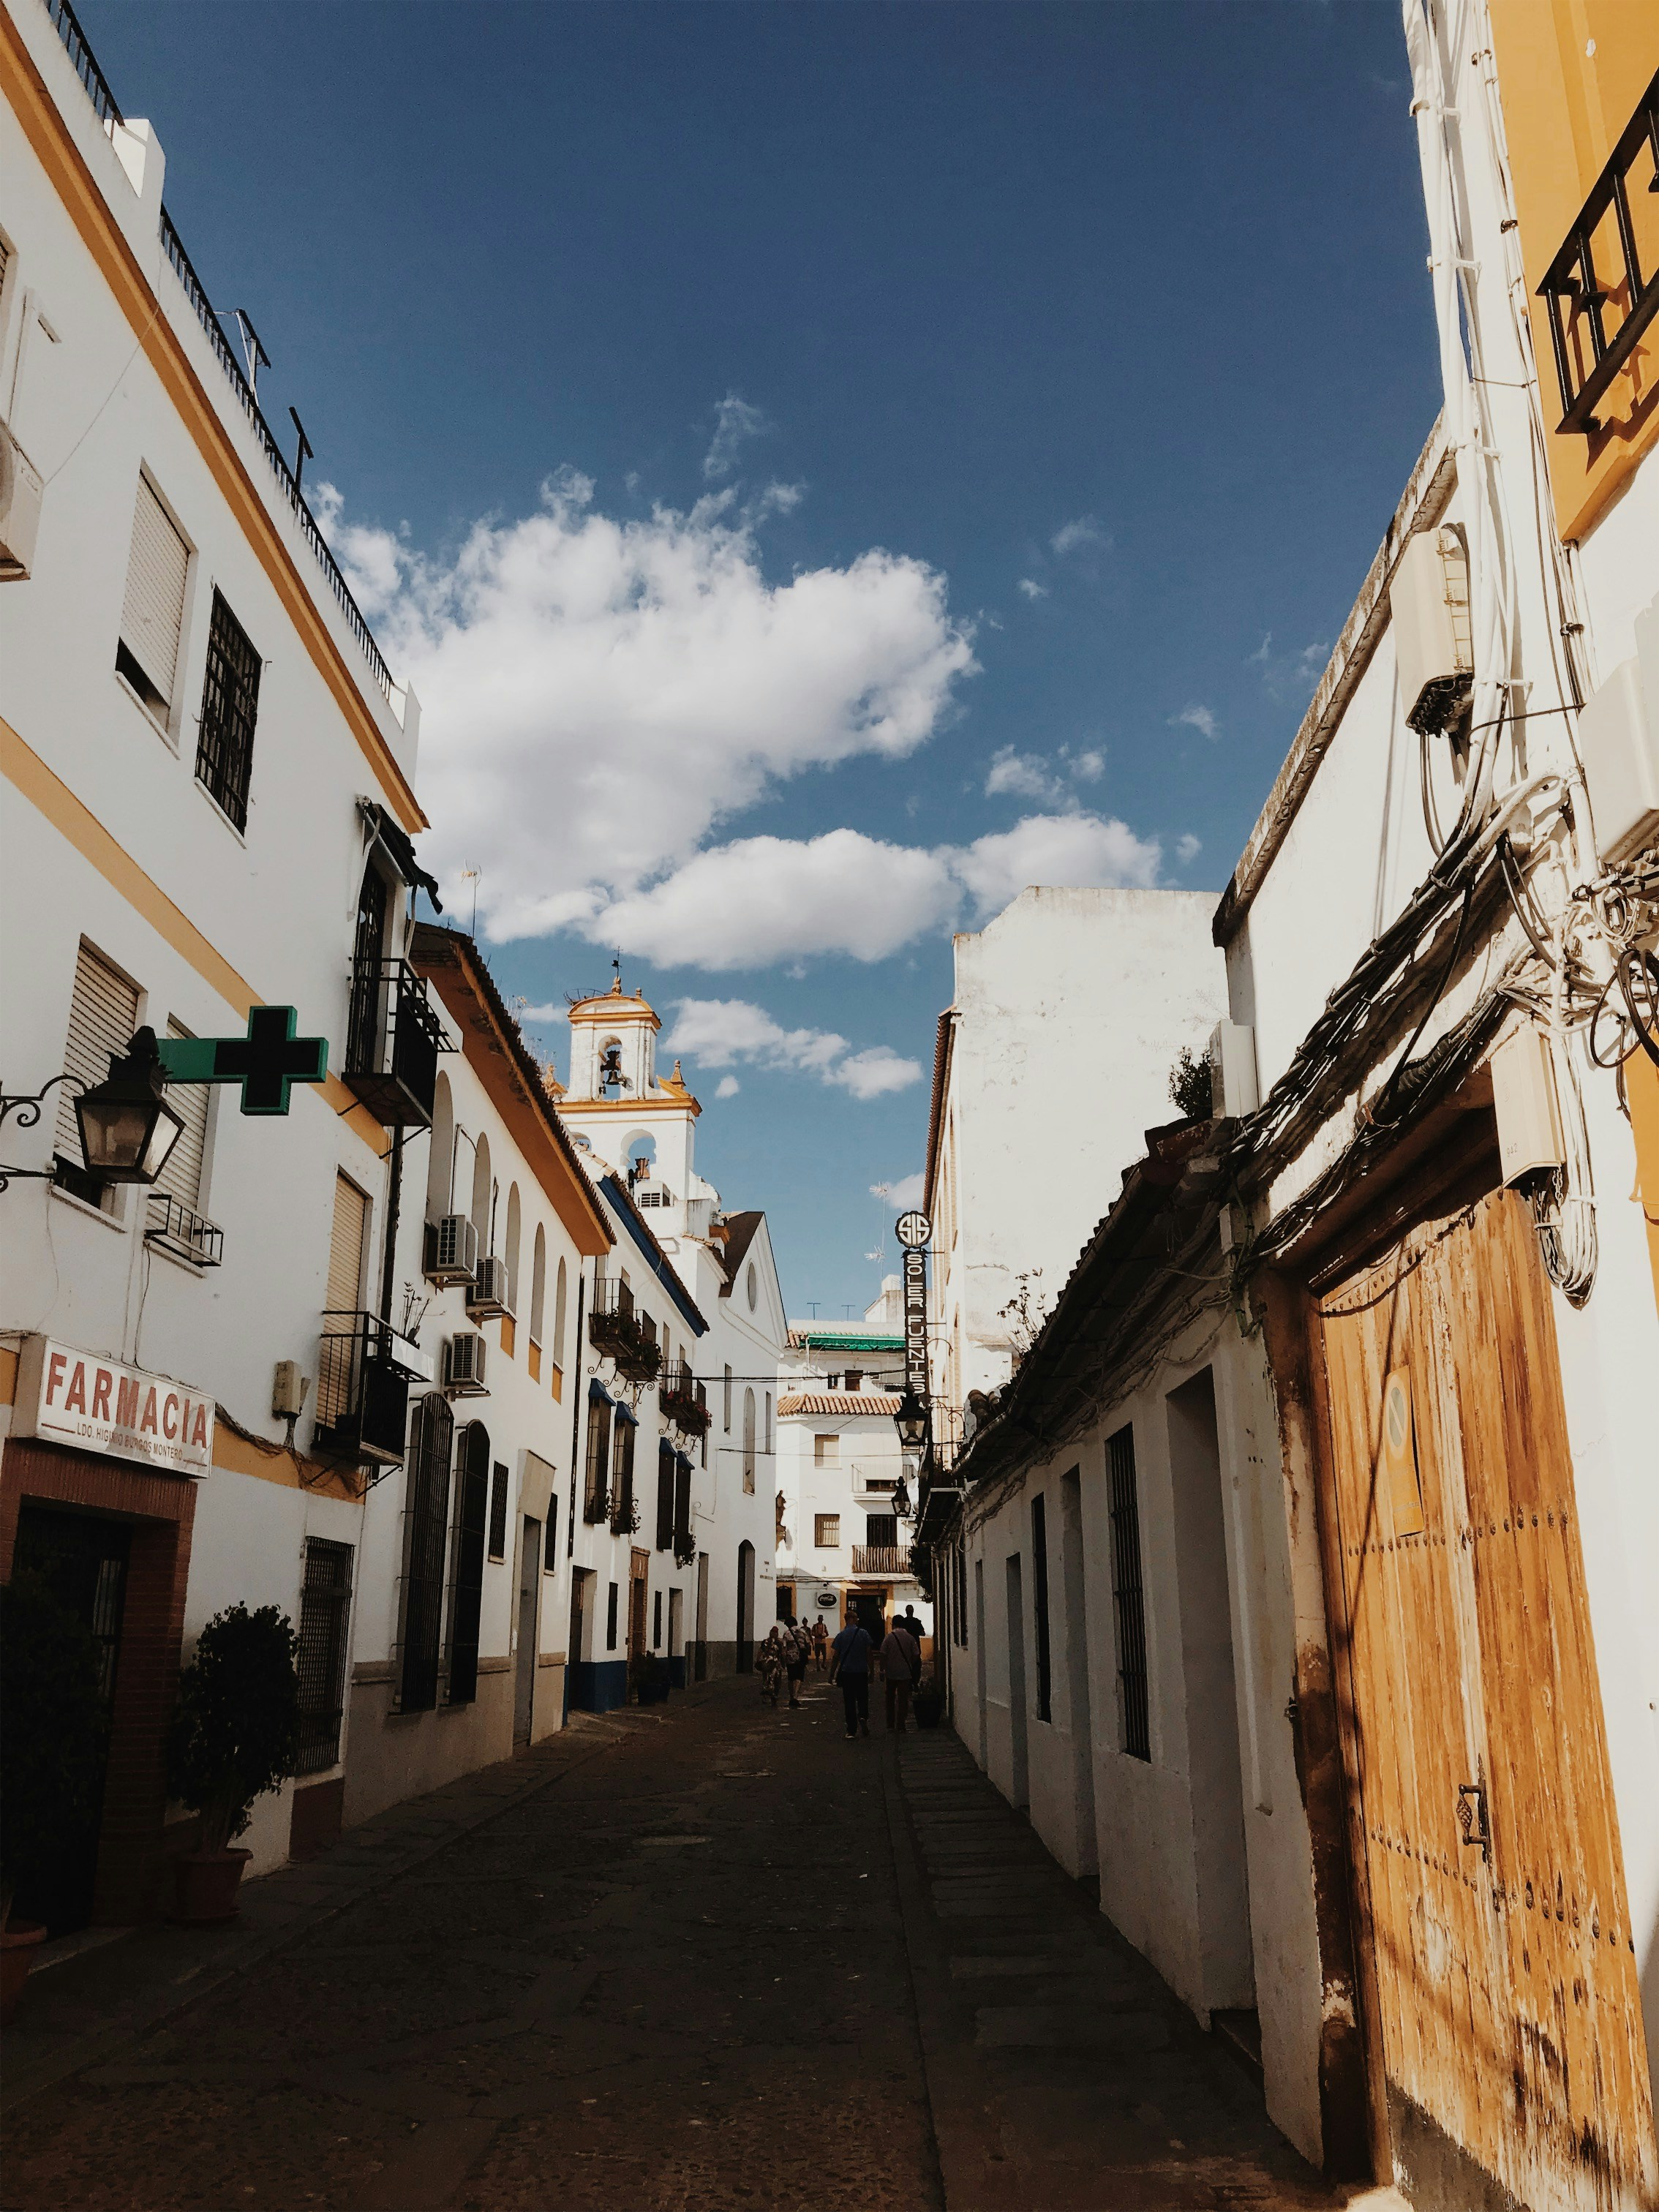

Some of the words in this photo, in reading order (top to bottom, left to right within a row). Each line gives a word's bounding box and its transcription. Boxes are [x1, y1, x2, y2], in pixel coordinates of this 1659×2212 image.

[906, 1254, 924, 1309] SOLER
[907, 1314, 926, 1394] FUENTES
[45, 1352, 207, 1449] FARMACIA
[77, 1422, 94, 1439] LDO.
[124, 1434, 152, 1453] BURGOS
[154, 1443, 183, 1461] MONTERO
